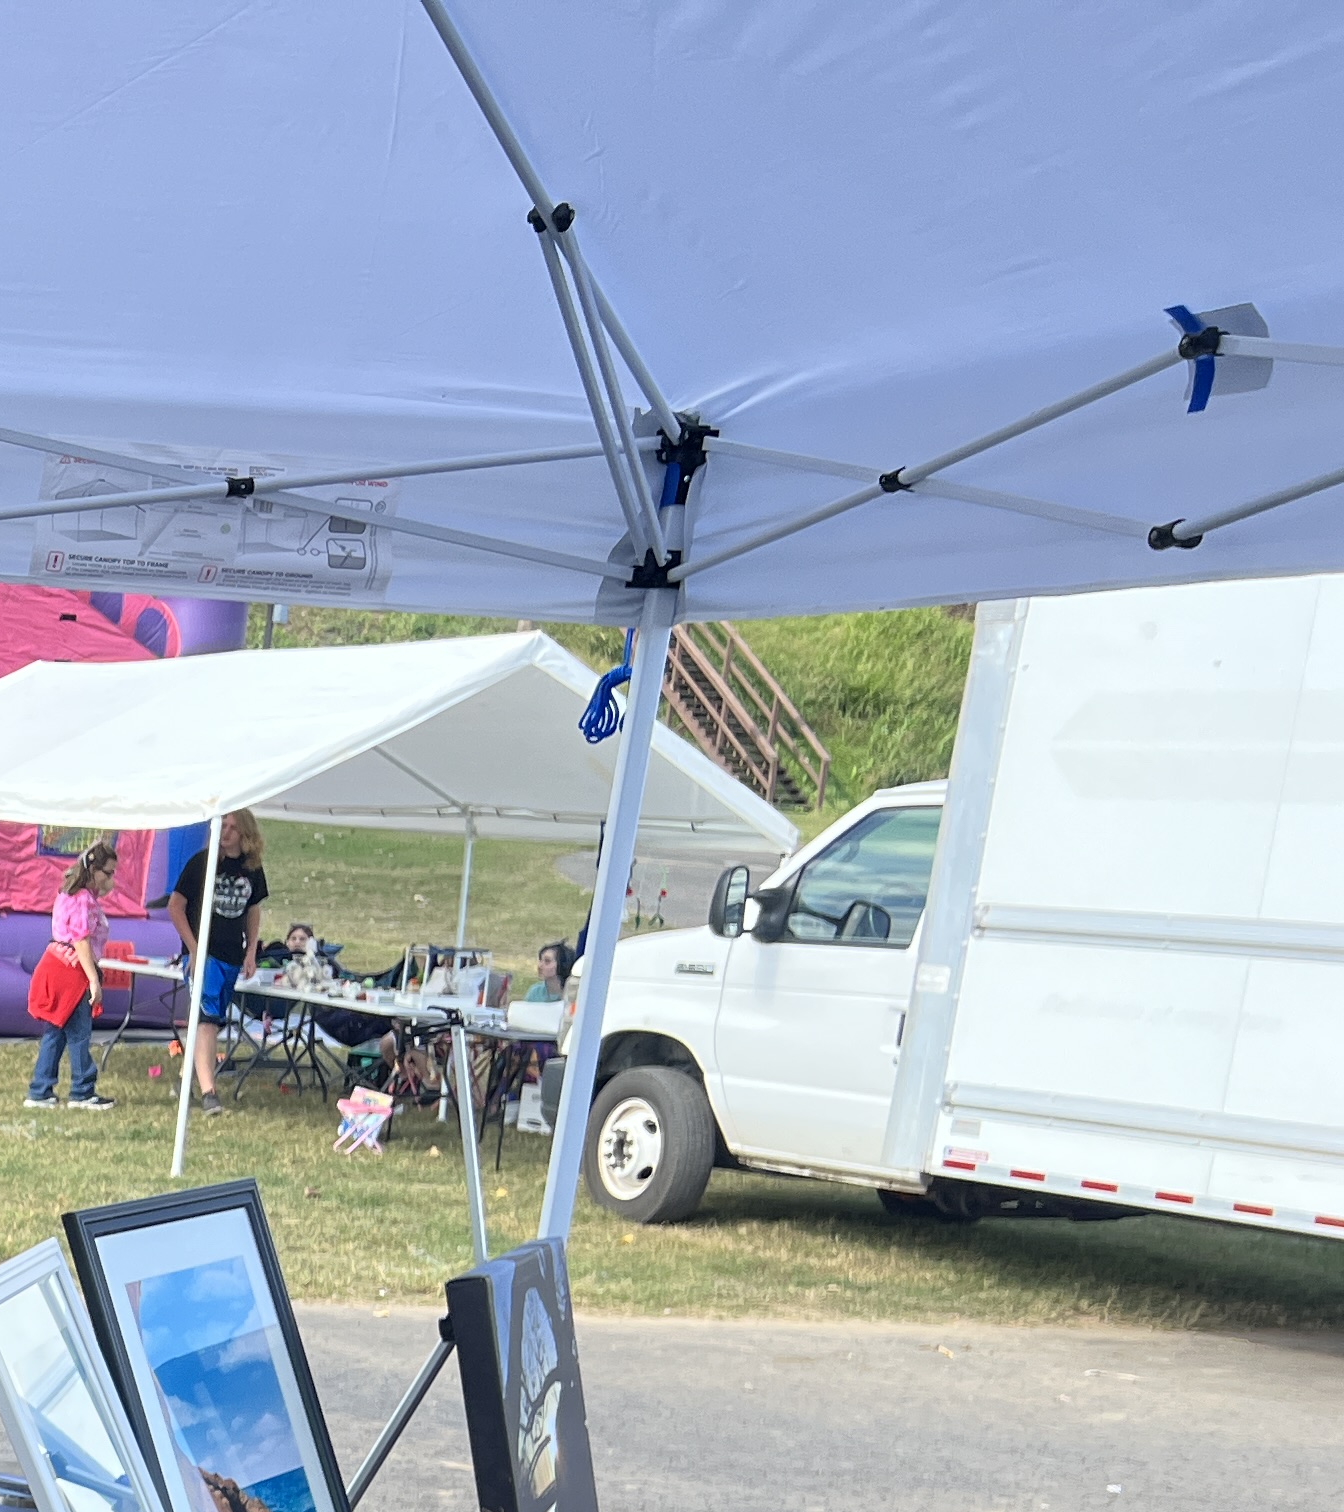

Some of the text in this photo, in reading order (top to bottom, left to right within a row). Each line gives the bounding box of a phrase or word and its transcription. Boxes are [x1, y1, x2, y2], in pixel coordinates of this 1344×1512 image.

[68, 553, 94, 562] SECURE
[94, 555, 122, 564] CANOPY
[122, 558, 136, 566] TOP
